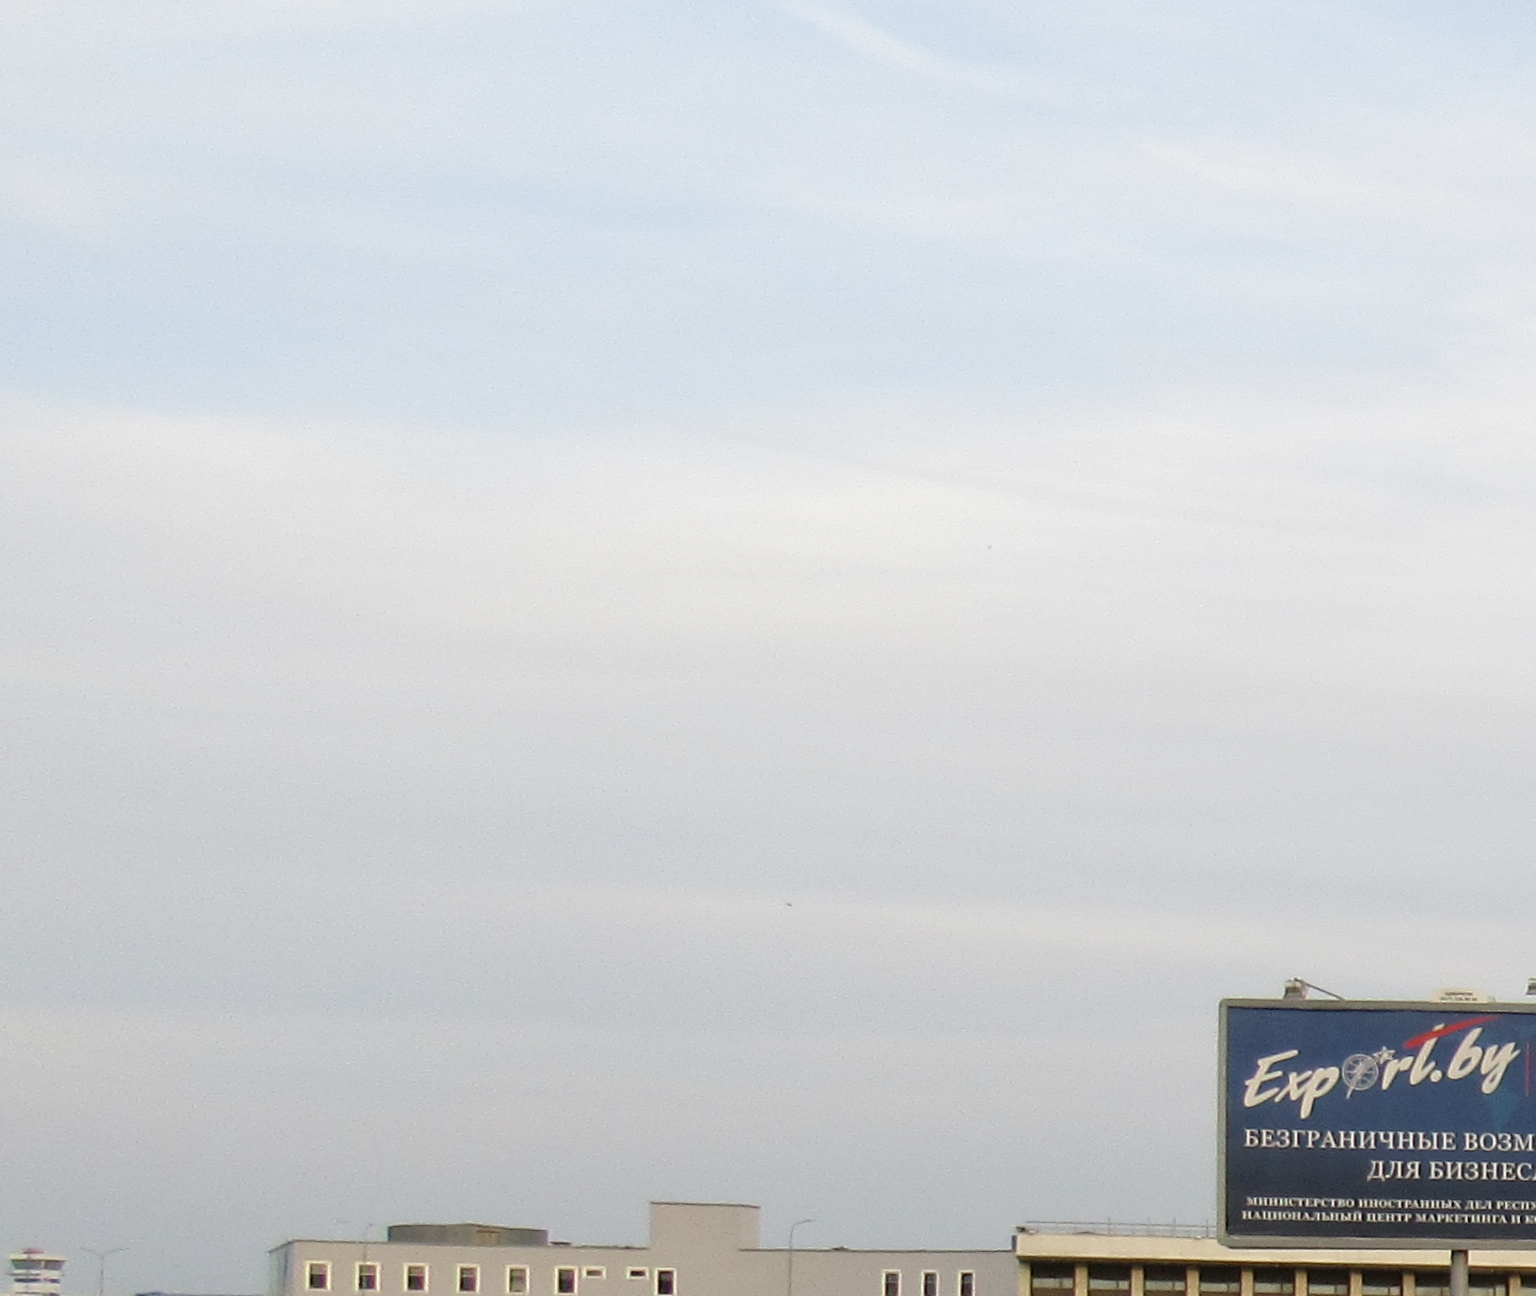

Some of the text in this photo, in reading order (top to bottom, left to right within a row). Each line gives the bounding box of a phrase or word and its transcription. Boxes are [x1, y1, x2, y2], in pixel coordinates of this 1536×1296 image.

[1243, 1021, 1522, 1120] Export.by
[1243, 1127, 1458, 1151] БЕЗГРАНИЧНЫЕ
[1366, 1159, 1422, 1182] ДЛЯ
[1246, 1196, 1356, 1209] МИНИСТЕРСТВО
[1358, 1198, 1463, 1210] ИНОСТРАННЫХ
[1464, 1200, 1493, 1211] ДЕЛ
[1241, 1209, 1363, 1222] НАЦИОНАЛЬНЫЙ
[1366, 1212, 1413, 1224] ЦЕНТР
[1415, 1213, 1508, 1225] МАРКЕТИНГА
[1511, 1214, 1522, 1225] И
